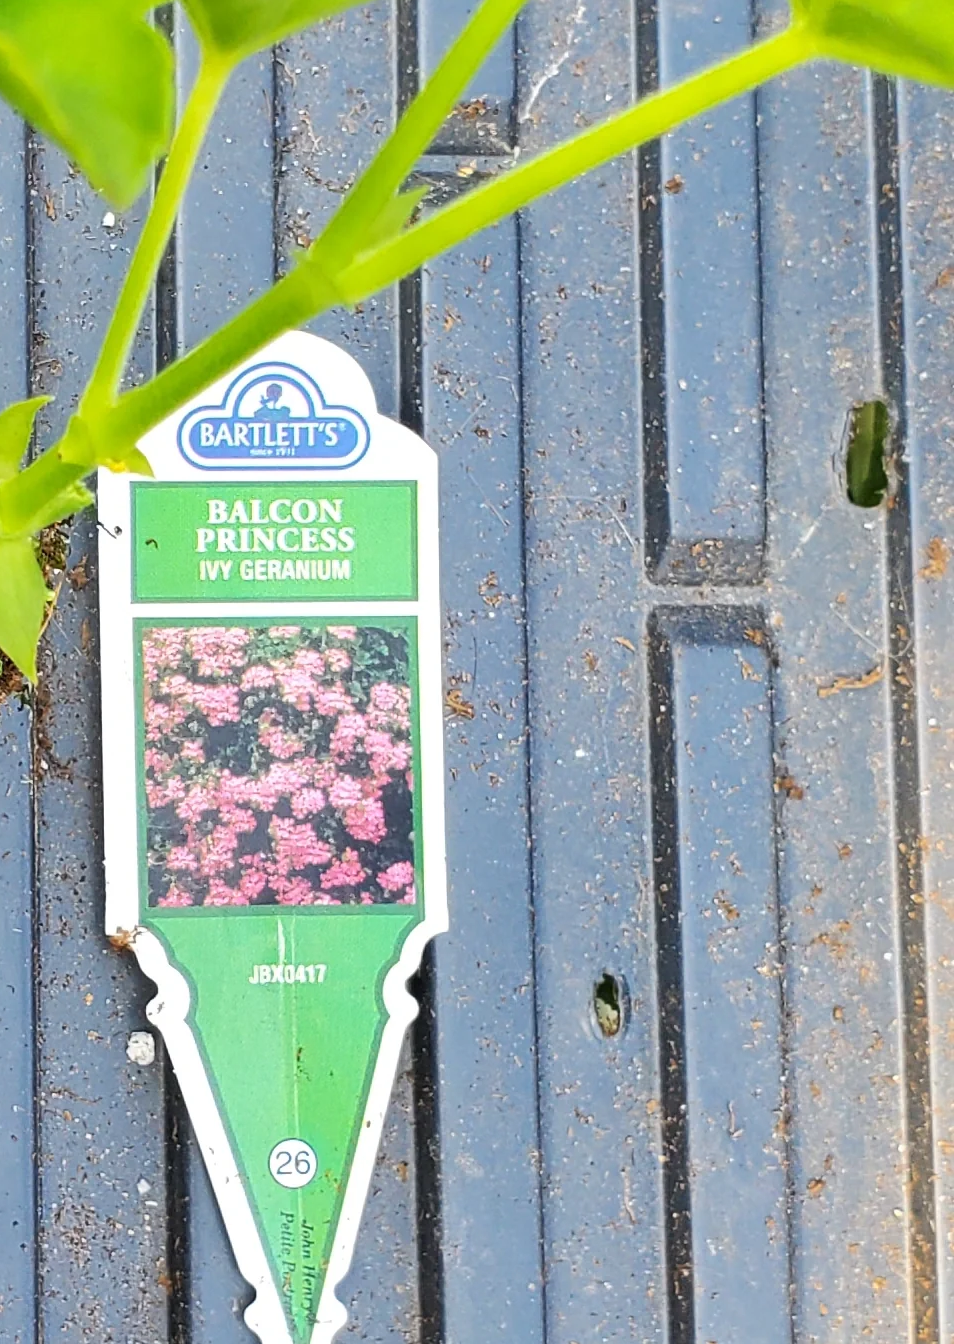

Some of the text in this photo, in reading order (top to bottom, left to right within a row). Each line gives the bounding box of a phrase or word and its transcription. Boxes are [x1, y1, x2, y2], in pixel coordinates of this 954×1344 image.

[206, 498, 343, 524] BALCON
[195, 527, 356, 553] PRINCESS
[199, 558, 351, 581] IVY GERANIUM
[248, 964, 327, 985] JBX0417
[276, 1150, 311, 1175] 26
[279, 1211, 296, 1256] Petite
[301, 1219, 315, 1259] John
